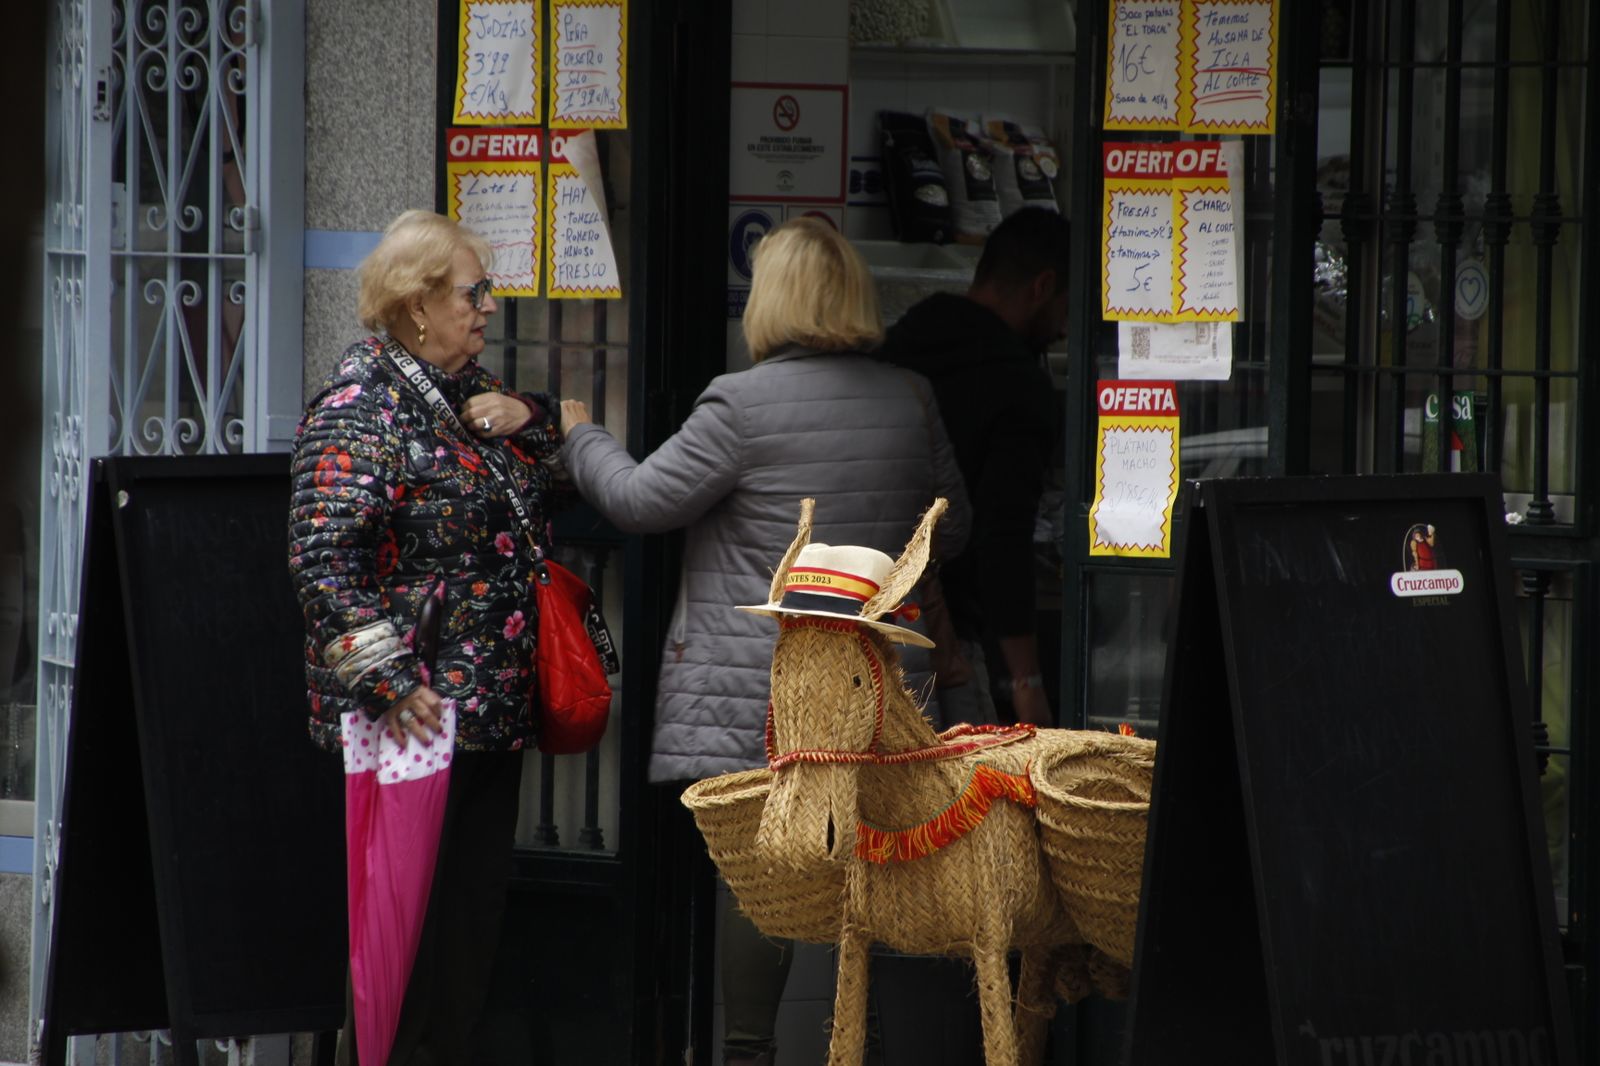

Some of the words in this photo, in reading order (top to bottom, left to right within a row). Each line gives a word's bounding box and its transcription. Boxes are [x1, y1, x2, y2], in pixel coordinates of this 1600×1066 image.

[1206, 48, 1250, 69] ISLA
[1203, 71, 1220, 93] AL
[450, 134, 539, 158] OFERTA
[1106, 149, 1173, 174] OFERT
[1175, 149, 1228, 172] OFE
[562, 186, 587, 205] HAY
[1117, 201, 1158, 220] FRESAS
[1199, 221, 1212, 233] AL
[1215, 223, 1235, 233] CORT
[559, 261, 606, 282] FRESCO
[1100, 387, 1176, 411] OFERTA
[1122, 457, 1157, 472] MACHO
[506, 488, 525, 517] RED
[811, 575, 832, 585] 2023
[1397, 576, 1460, 592] Cruzcampo
